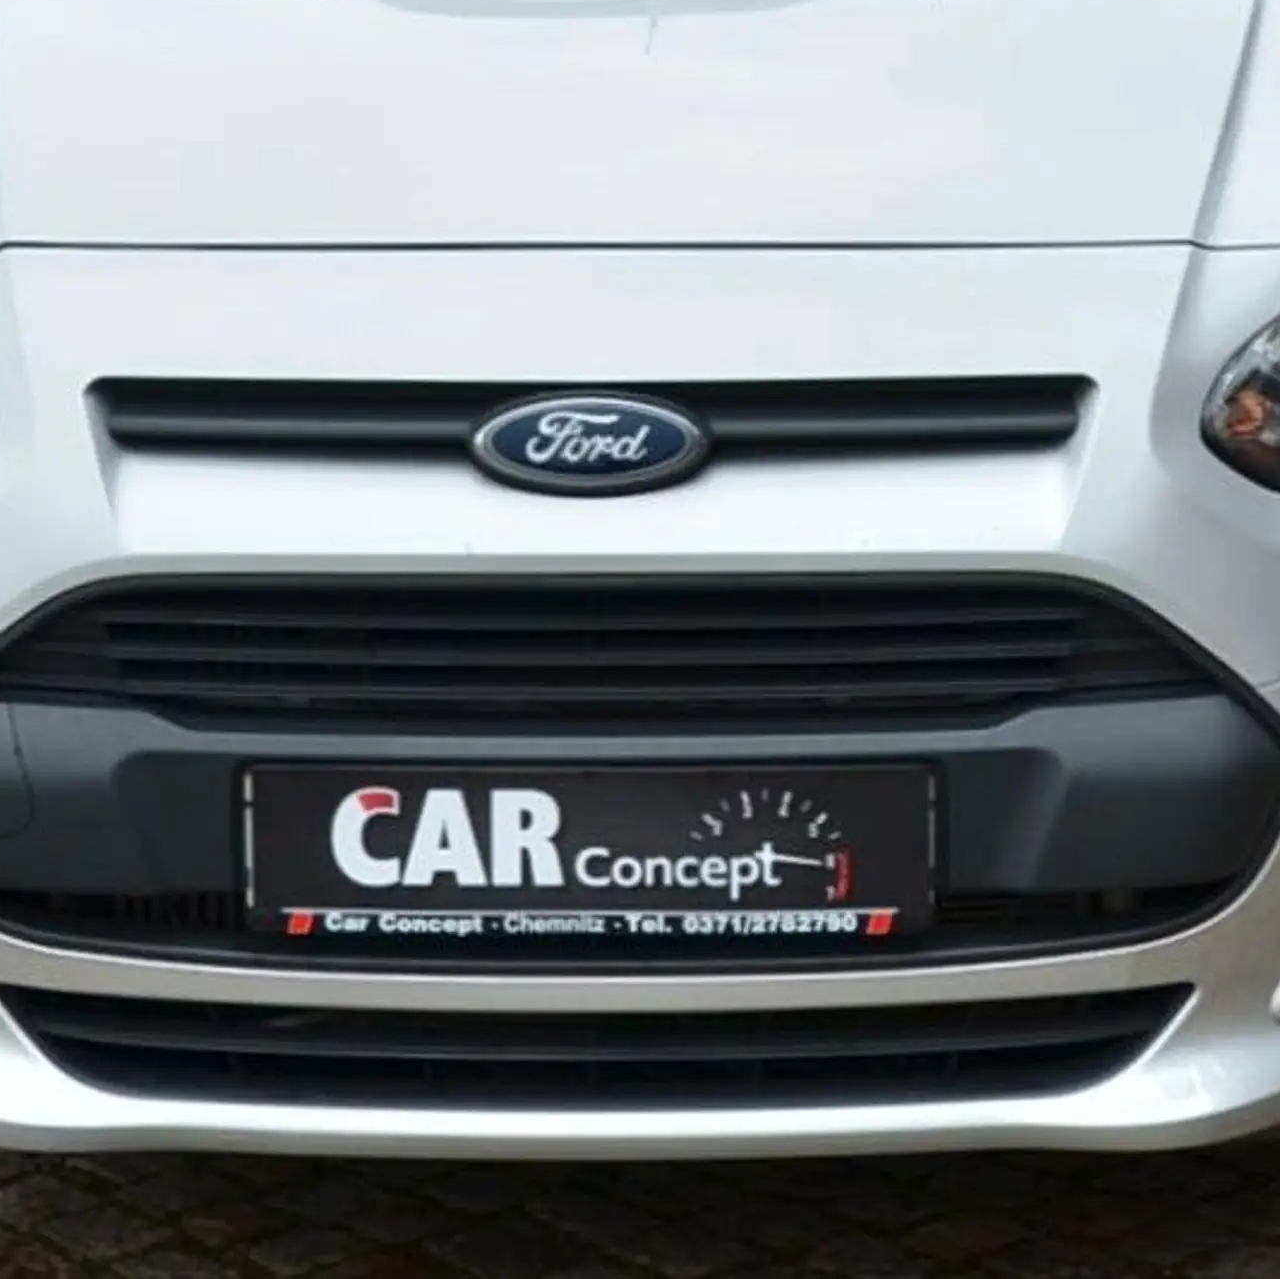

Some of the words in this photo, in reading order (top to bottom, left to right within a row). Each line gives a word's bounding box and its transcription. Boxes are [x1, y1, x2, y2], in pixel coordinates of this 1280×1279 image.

[525, 411, 651, 463] Ford
[330, 786, 565, 888] CAR
[575, 841, 783, 902] Concept
[324, 911, 370, 933] Car
[377, 912, 483, 937] Concept
[503, 910, 606, 934] Chemnitz
